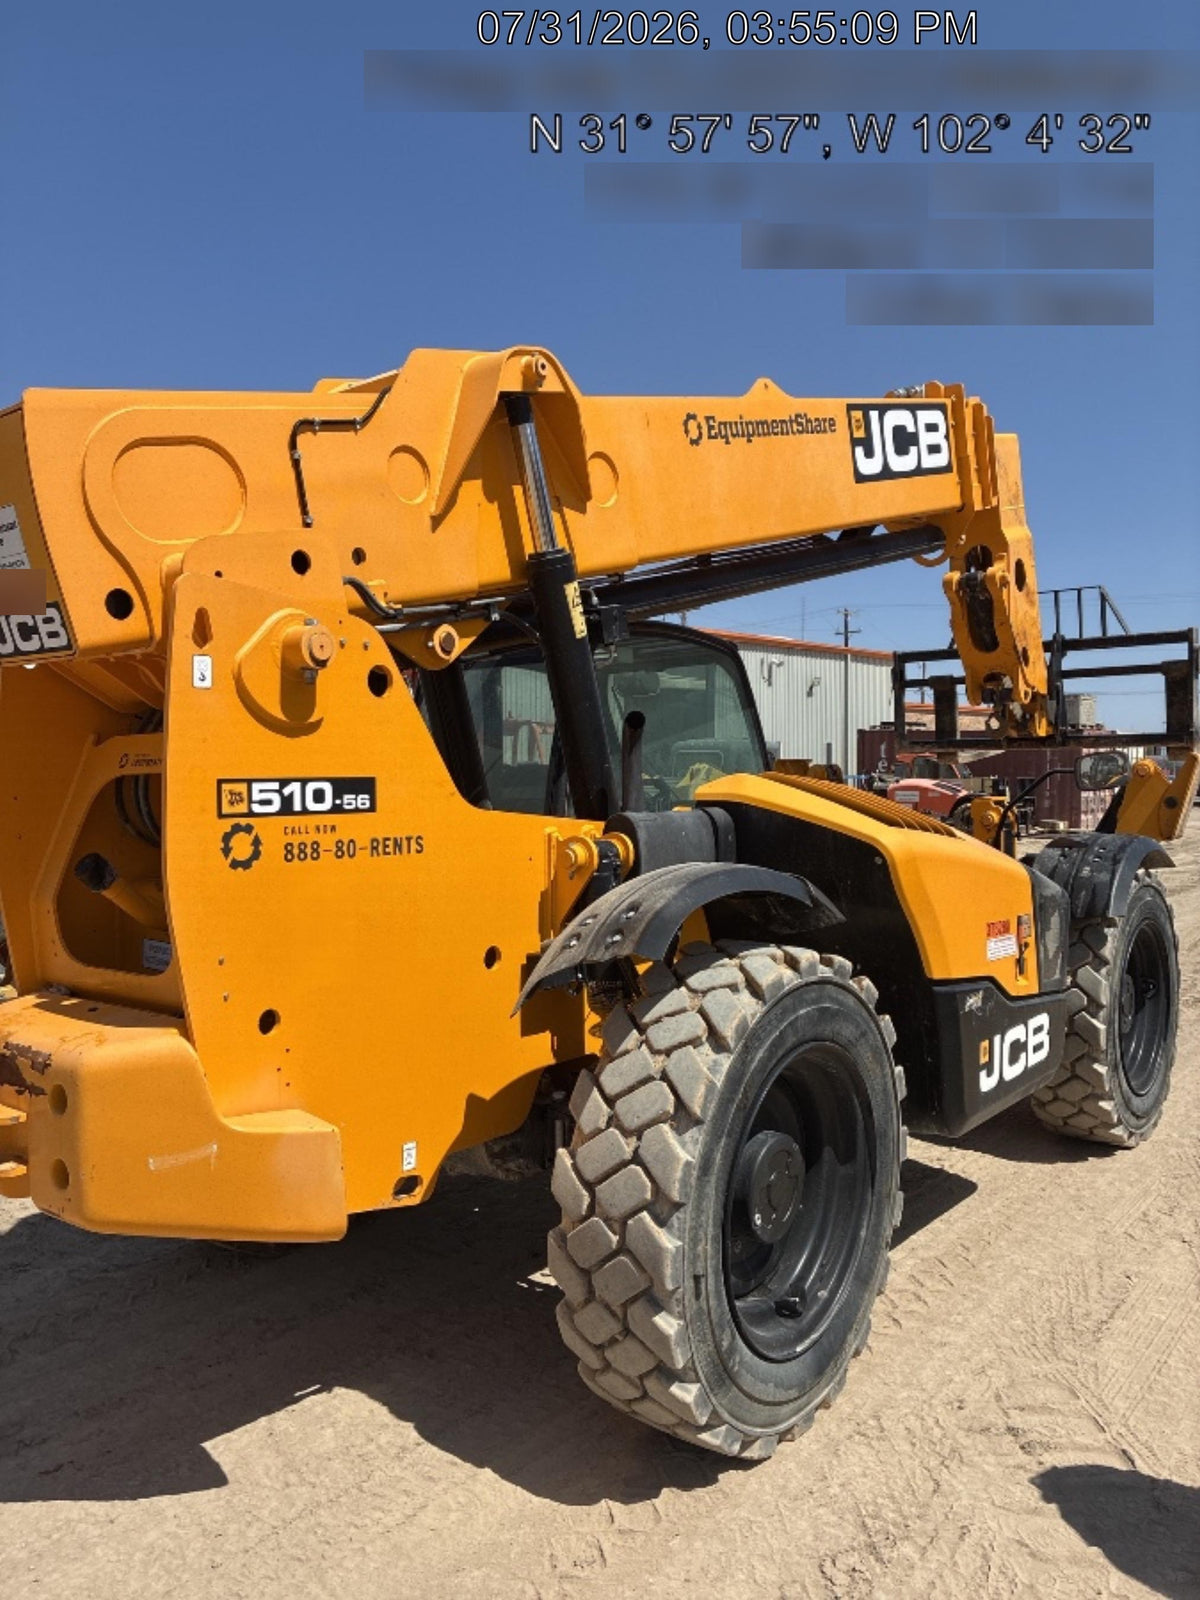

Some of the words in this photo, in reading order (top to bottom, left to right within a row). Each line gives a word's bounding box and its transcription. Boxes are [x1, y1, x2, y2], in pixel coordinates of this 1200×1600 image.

[704, 413, 837, 446] EquipmentShare
[854, 409, 951, 476] JCB
[283, 825, 310, 836] CALL
[315, 824, 337, 835] NOW
[283, 835, 424, 863] 888-80-RENTS
[978, 1012, 1050, 1093] JCB
